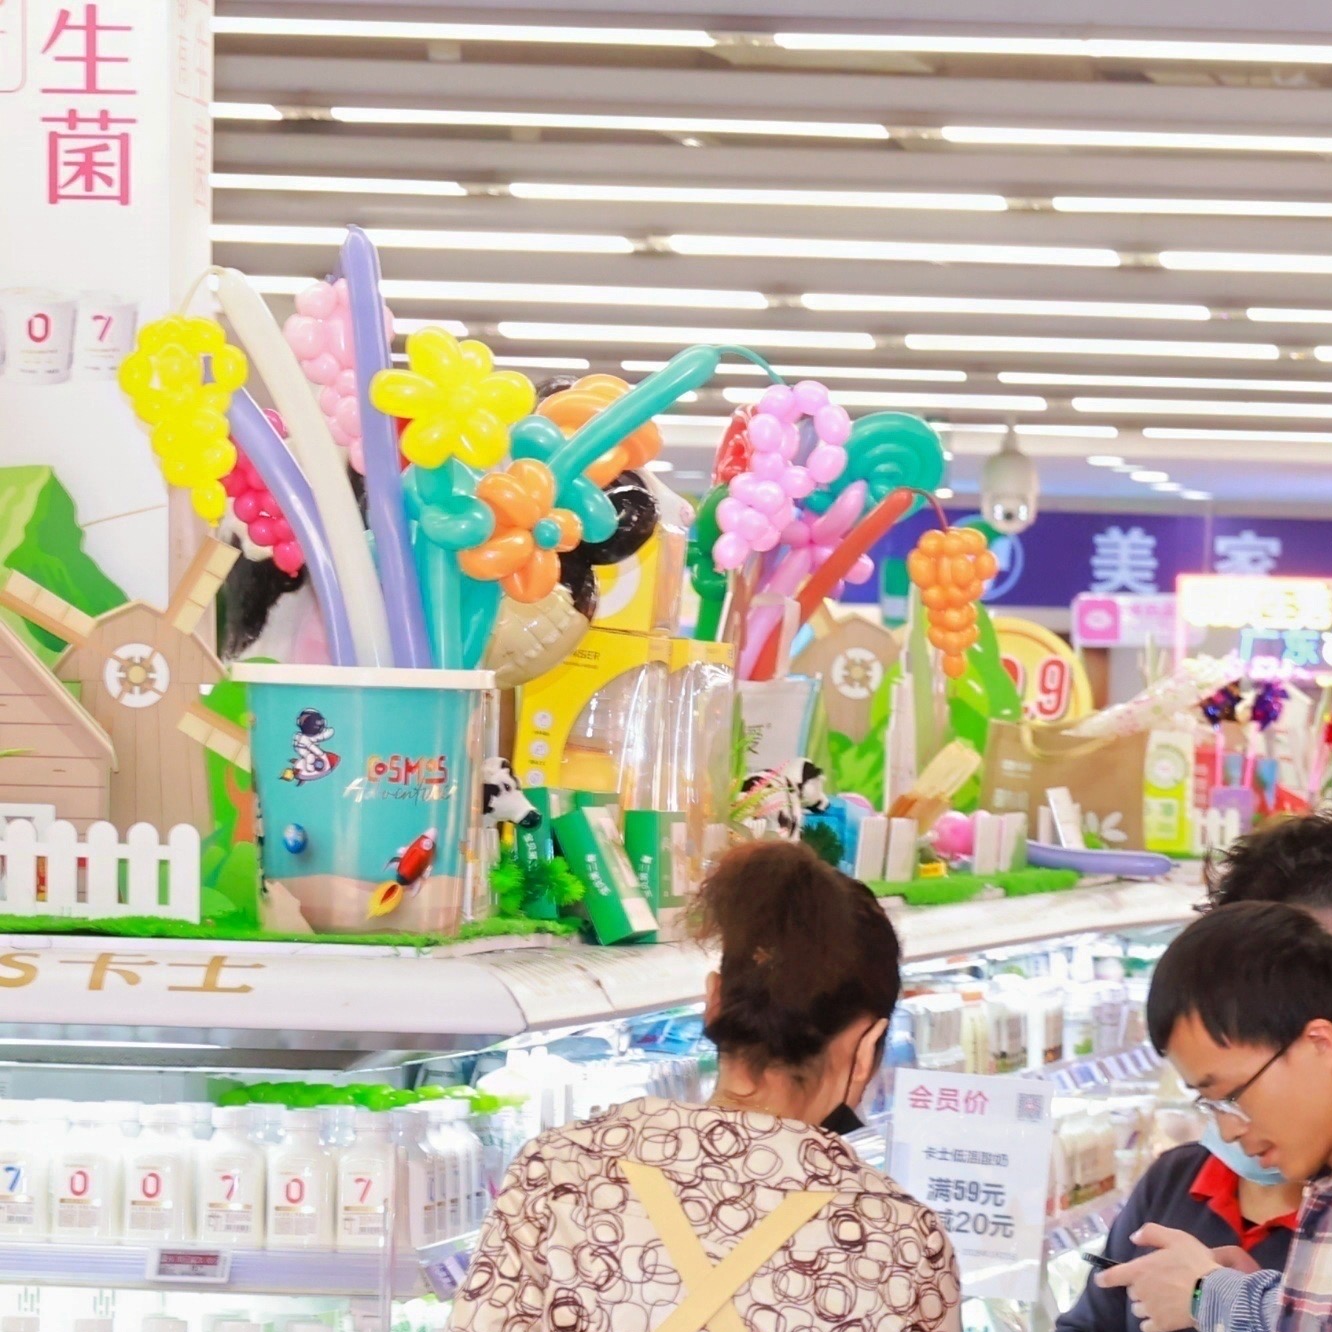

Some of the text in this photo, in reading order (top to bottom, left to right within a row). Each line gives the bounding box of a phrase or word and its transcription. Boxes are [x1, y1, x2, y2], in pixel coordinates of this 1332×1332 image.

[40, 3, 138, 206] 生菌
[59, 953, 267, 993] 卡士
[908, 1084, 990, 1116] 会员价
[926, 1176, 1006, 1208] 满59元
